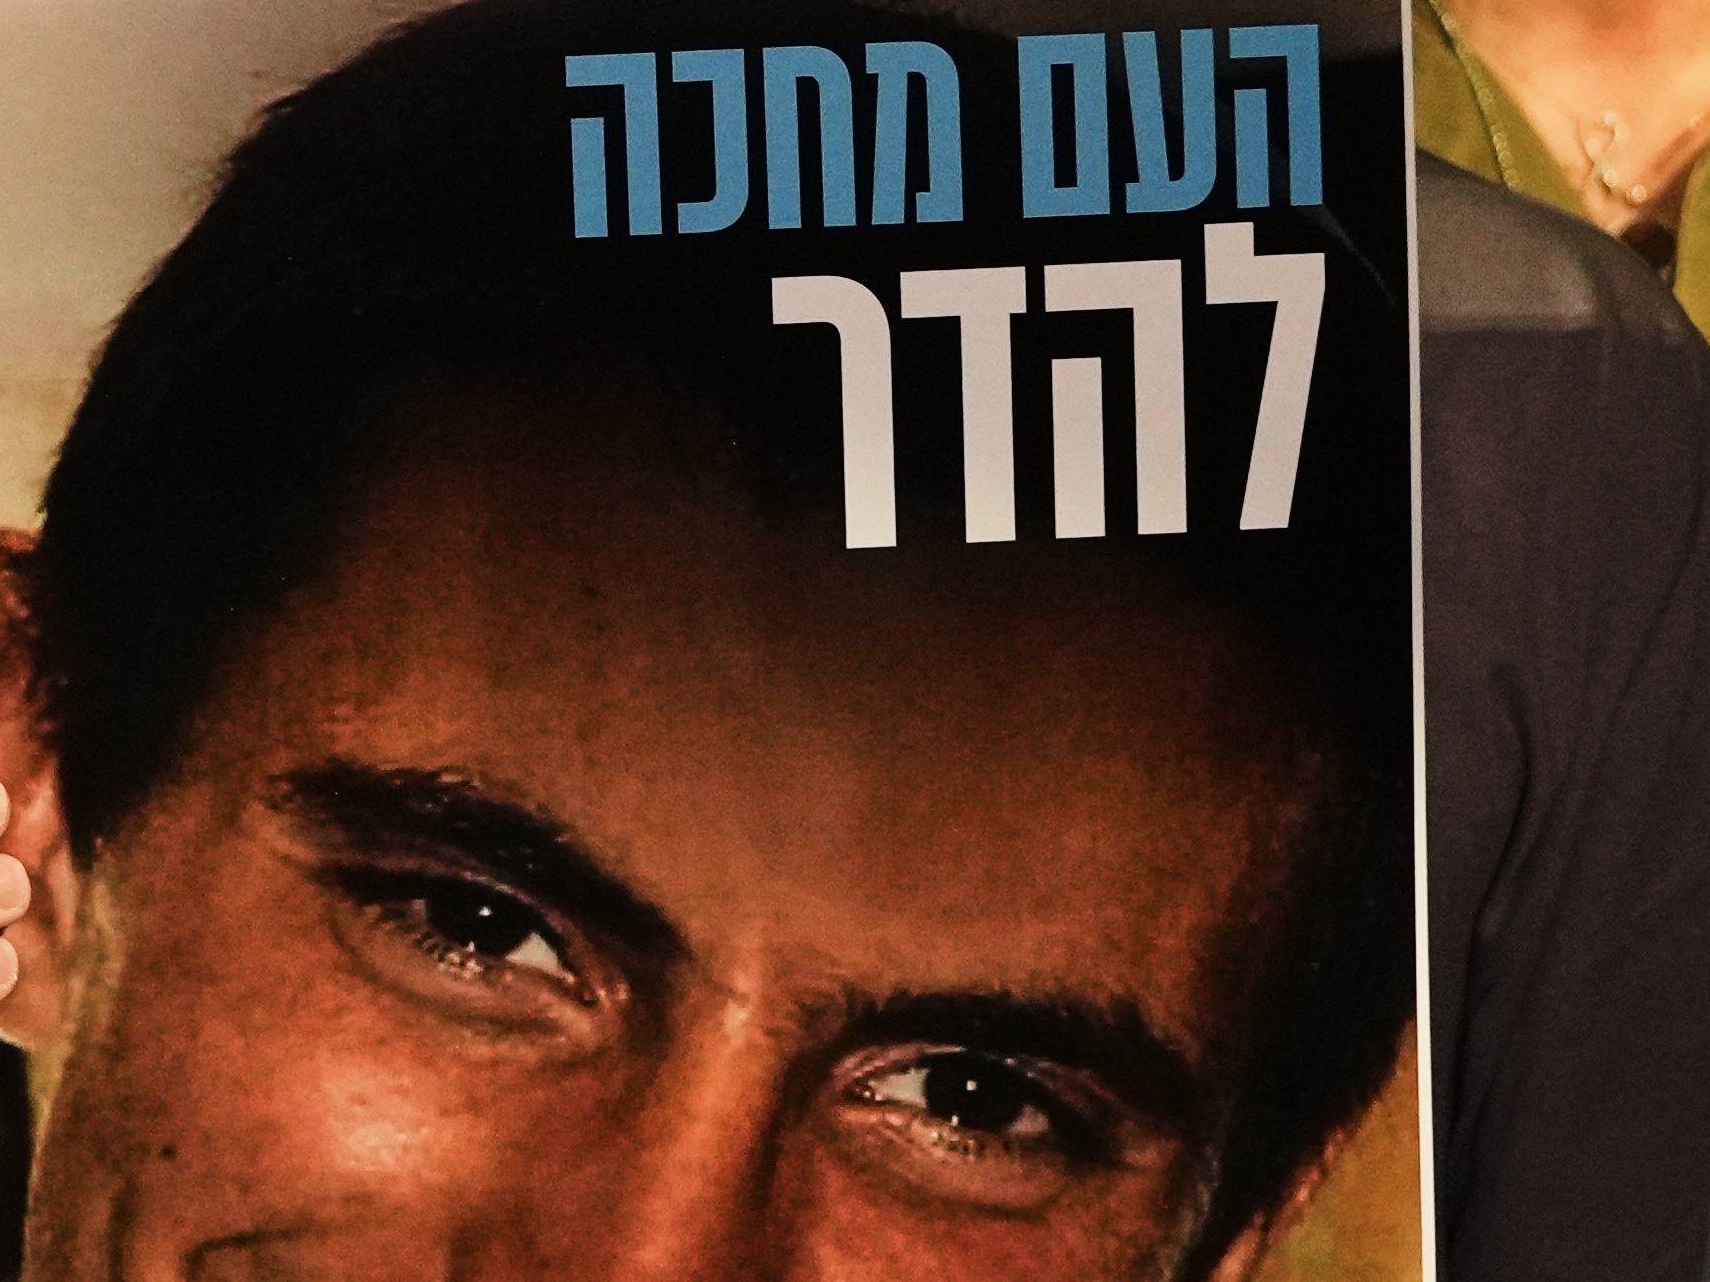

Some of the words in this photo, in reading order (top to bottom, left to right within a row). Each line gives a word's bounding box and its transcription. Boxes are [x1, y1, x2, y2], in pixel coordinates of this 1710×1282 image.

[565, 41, 964, 238] מחכה
[1018, 24, 1323, 218] העם
[772, 222, 1326, 549] להדר
